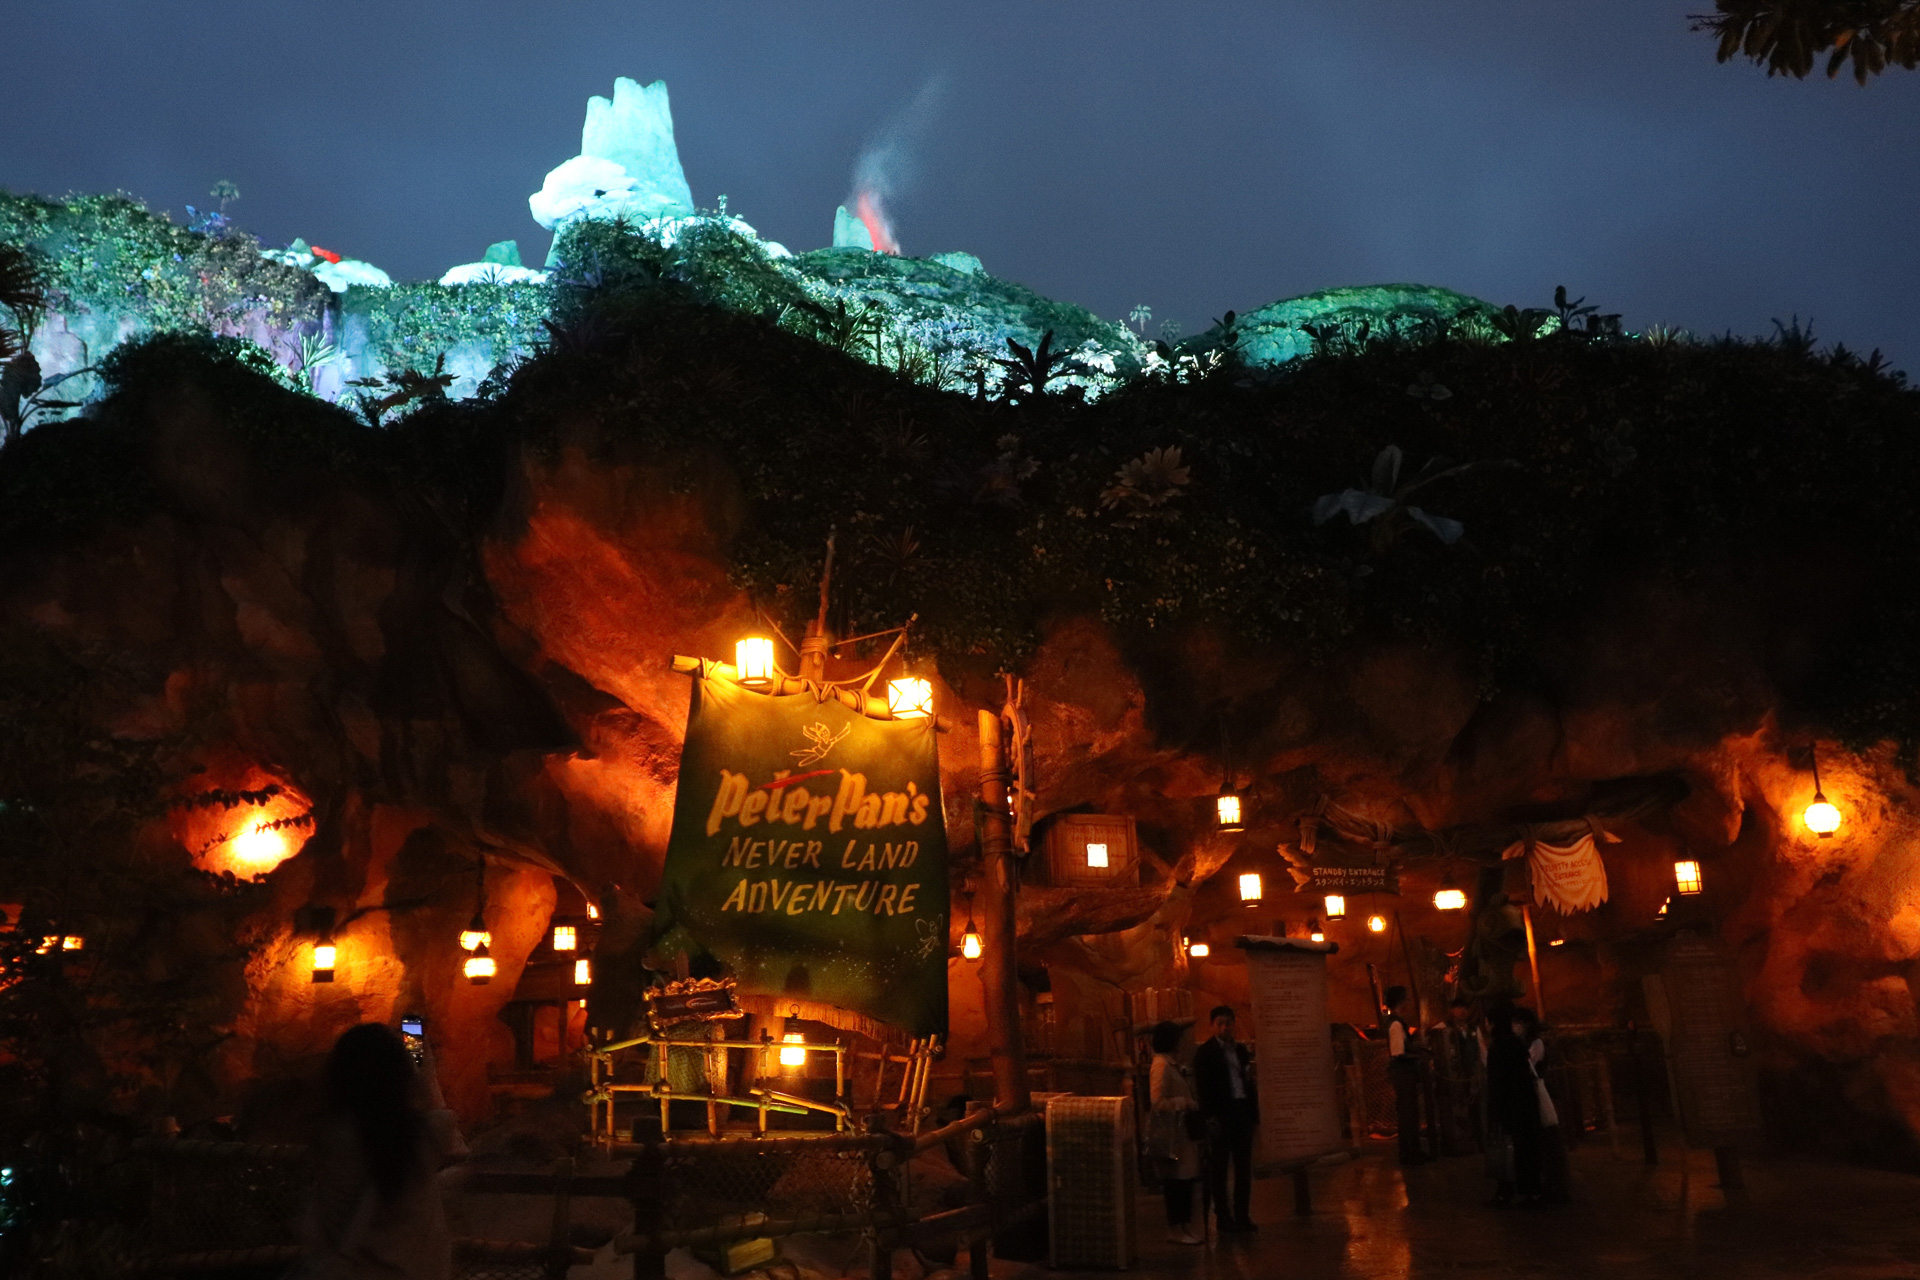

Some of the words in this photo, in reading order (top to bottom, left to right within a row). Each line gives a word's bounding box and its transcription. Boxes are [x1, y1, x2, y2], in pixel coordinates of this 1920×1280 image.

[706, 769, 832, 837] Peter
[829, 768, 930, 834] Pan's
[722, 836, 823, 869] NEVER
[841, 839, 919, 871] LAND
[1348, 867, 1385, 876] ENTRANCE
[721, 878, 920, 916] ADVENTURE
